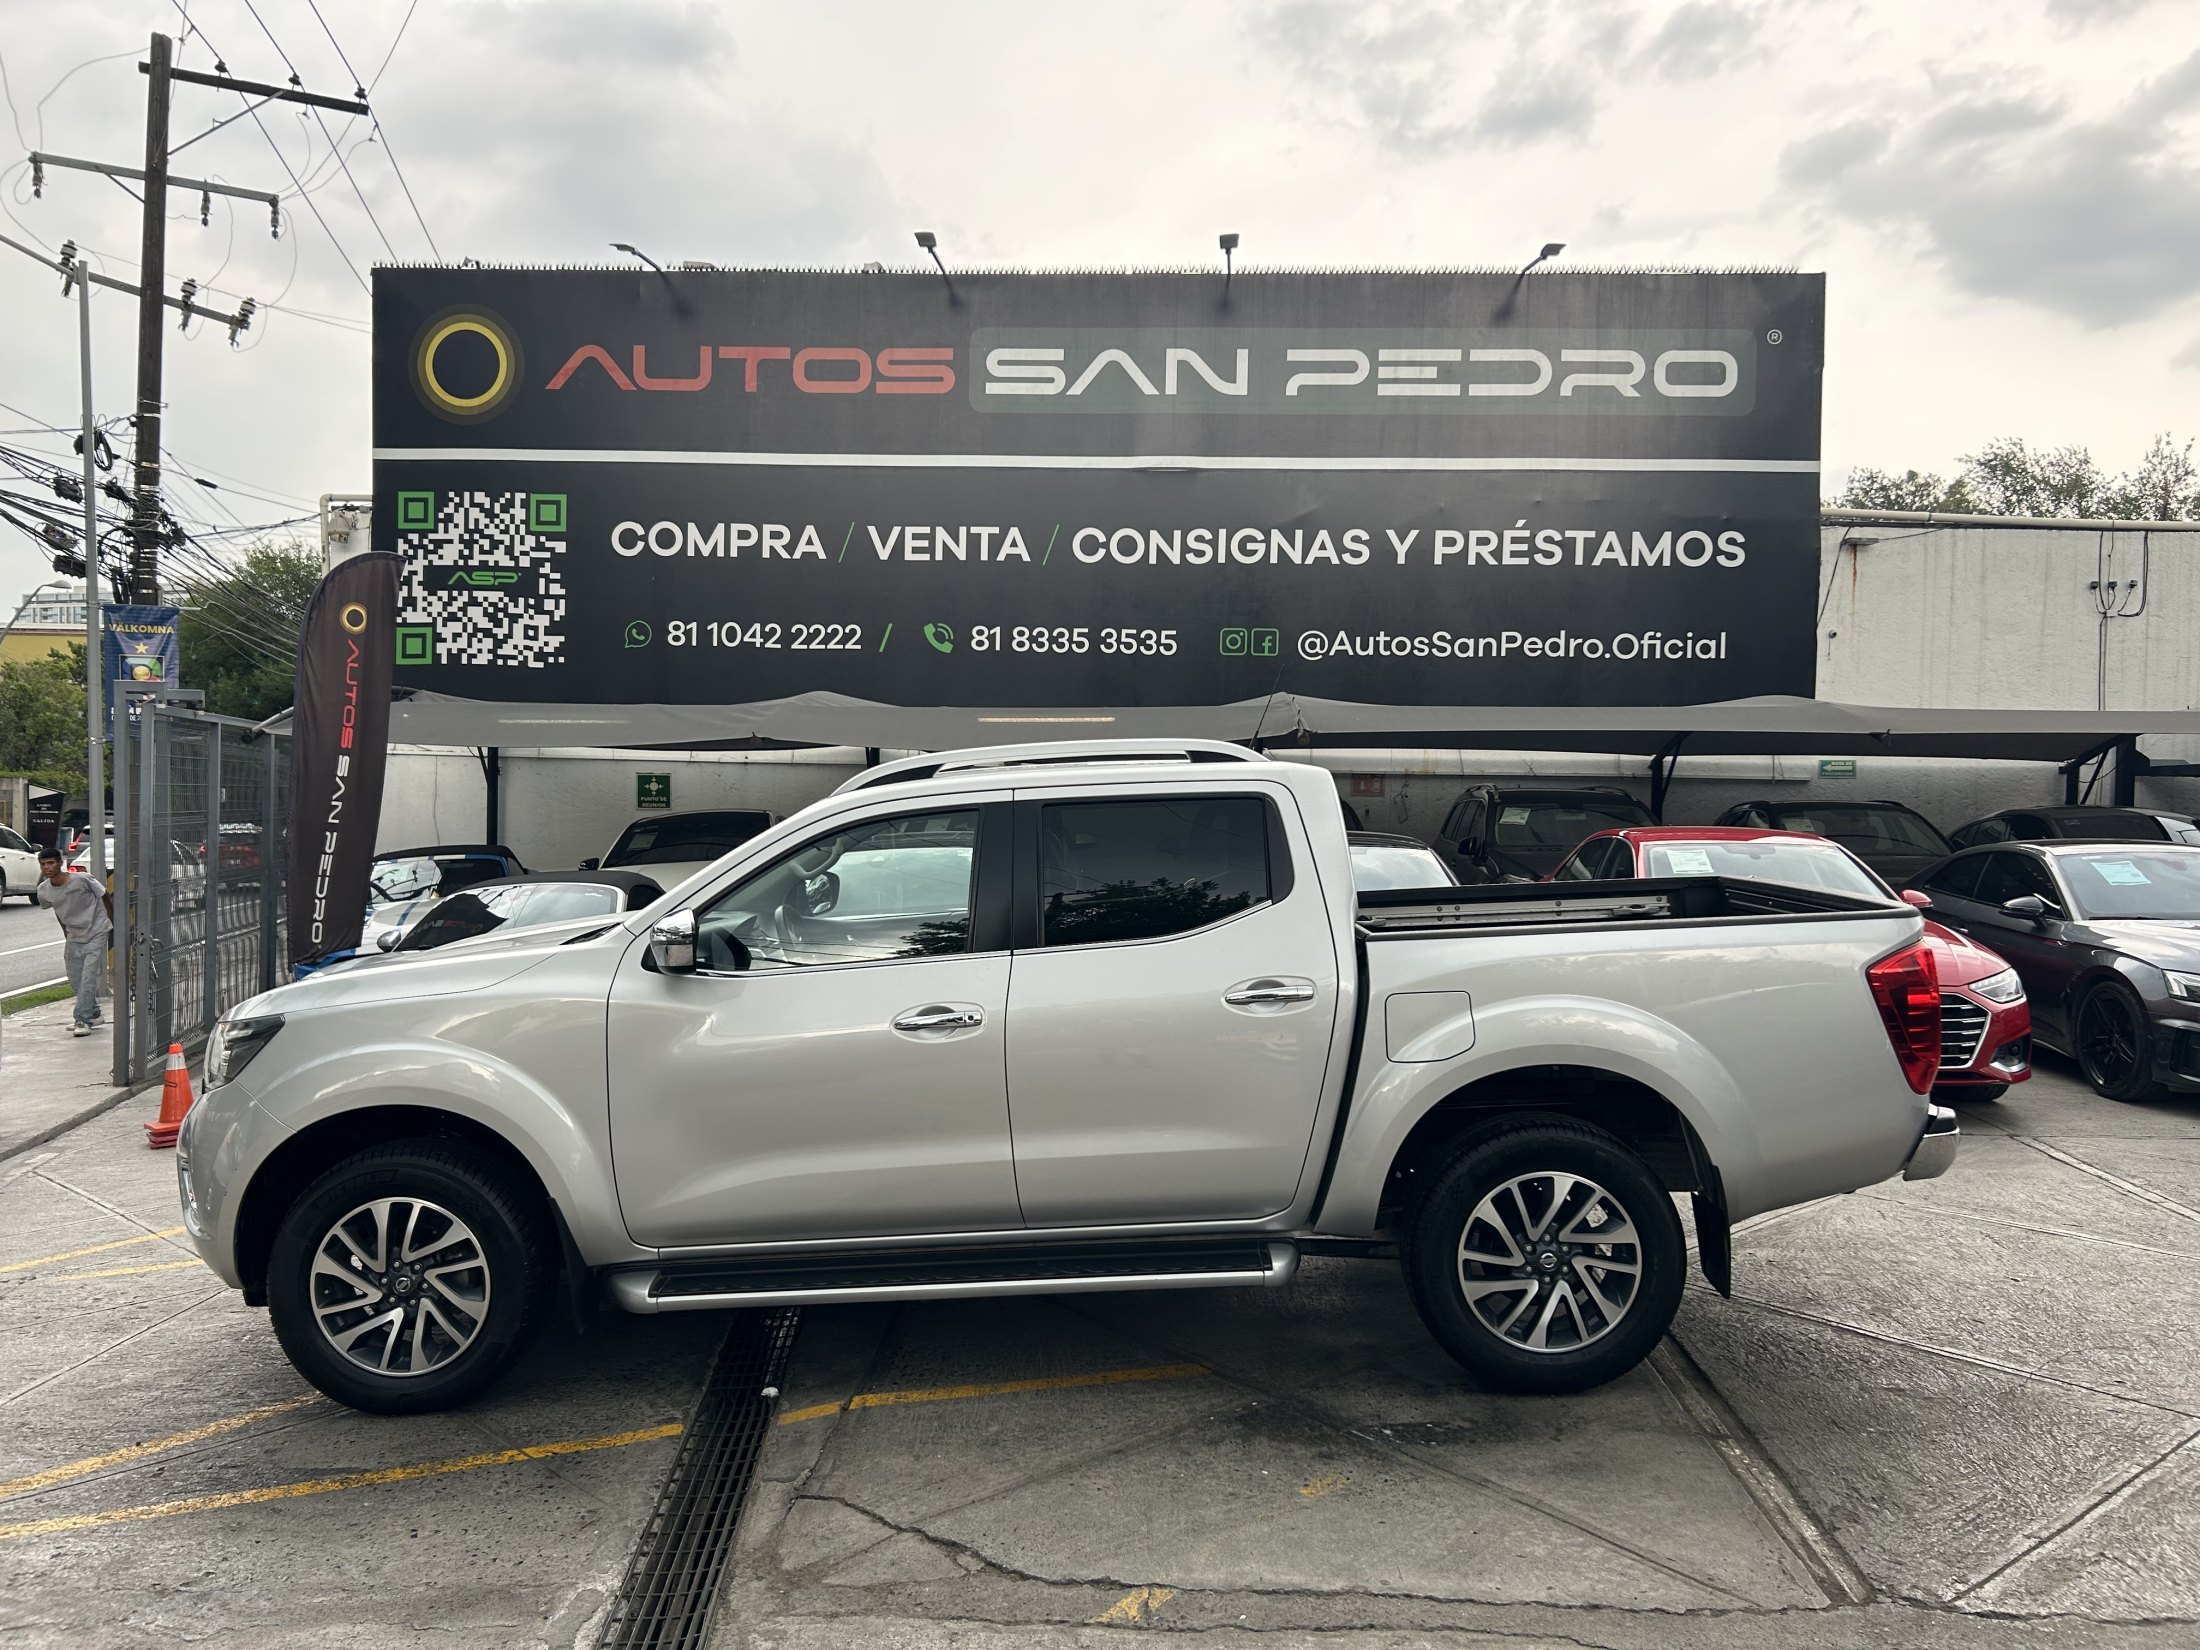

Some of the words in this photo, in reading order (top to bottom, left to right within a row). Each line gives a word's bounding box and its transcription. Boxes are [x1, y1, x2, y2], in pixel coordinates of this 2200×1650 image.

[545, 344, 956, 395] AUTOS
[985, 347, 1249, 396] SAN
[1285, 348, 1739, 398] PEDRO
[611, 520, 827, 560] COMPRA
[866, 525, 1032, 562] VENTA
[1072, 526, 1371, 566] CONSIGNAS
[1385, 528, 1420, 565] Y
[1433, 519, 1746, 568] PRÉSTAMOS
[108, 622, 175, 634] VÄLKOMNA
[667, 620, 697, 647] 81
[706, 621, 782, 649] 1042
[790, 623, 862, 650] 2222
[970, 625, 1001, 651] 81
[1011, 626, 1090, 654] 8335
[1099, 627, 1178, 656] 3535
[1297, 629, 1727, 662] @AutosSanPedro.Oficial
[340, 639, 360, 749] AUTOS
[328, 755, 350, 824] SAN
[311, 831, 338, 944] PEDRO
